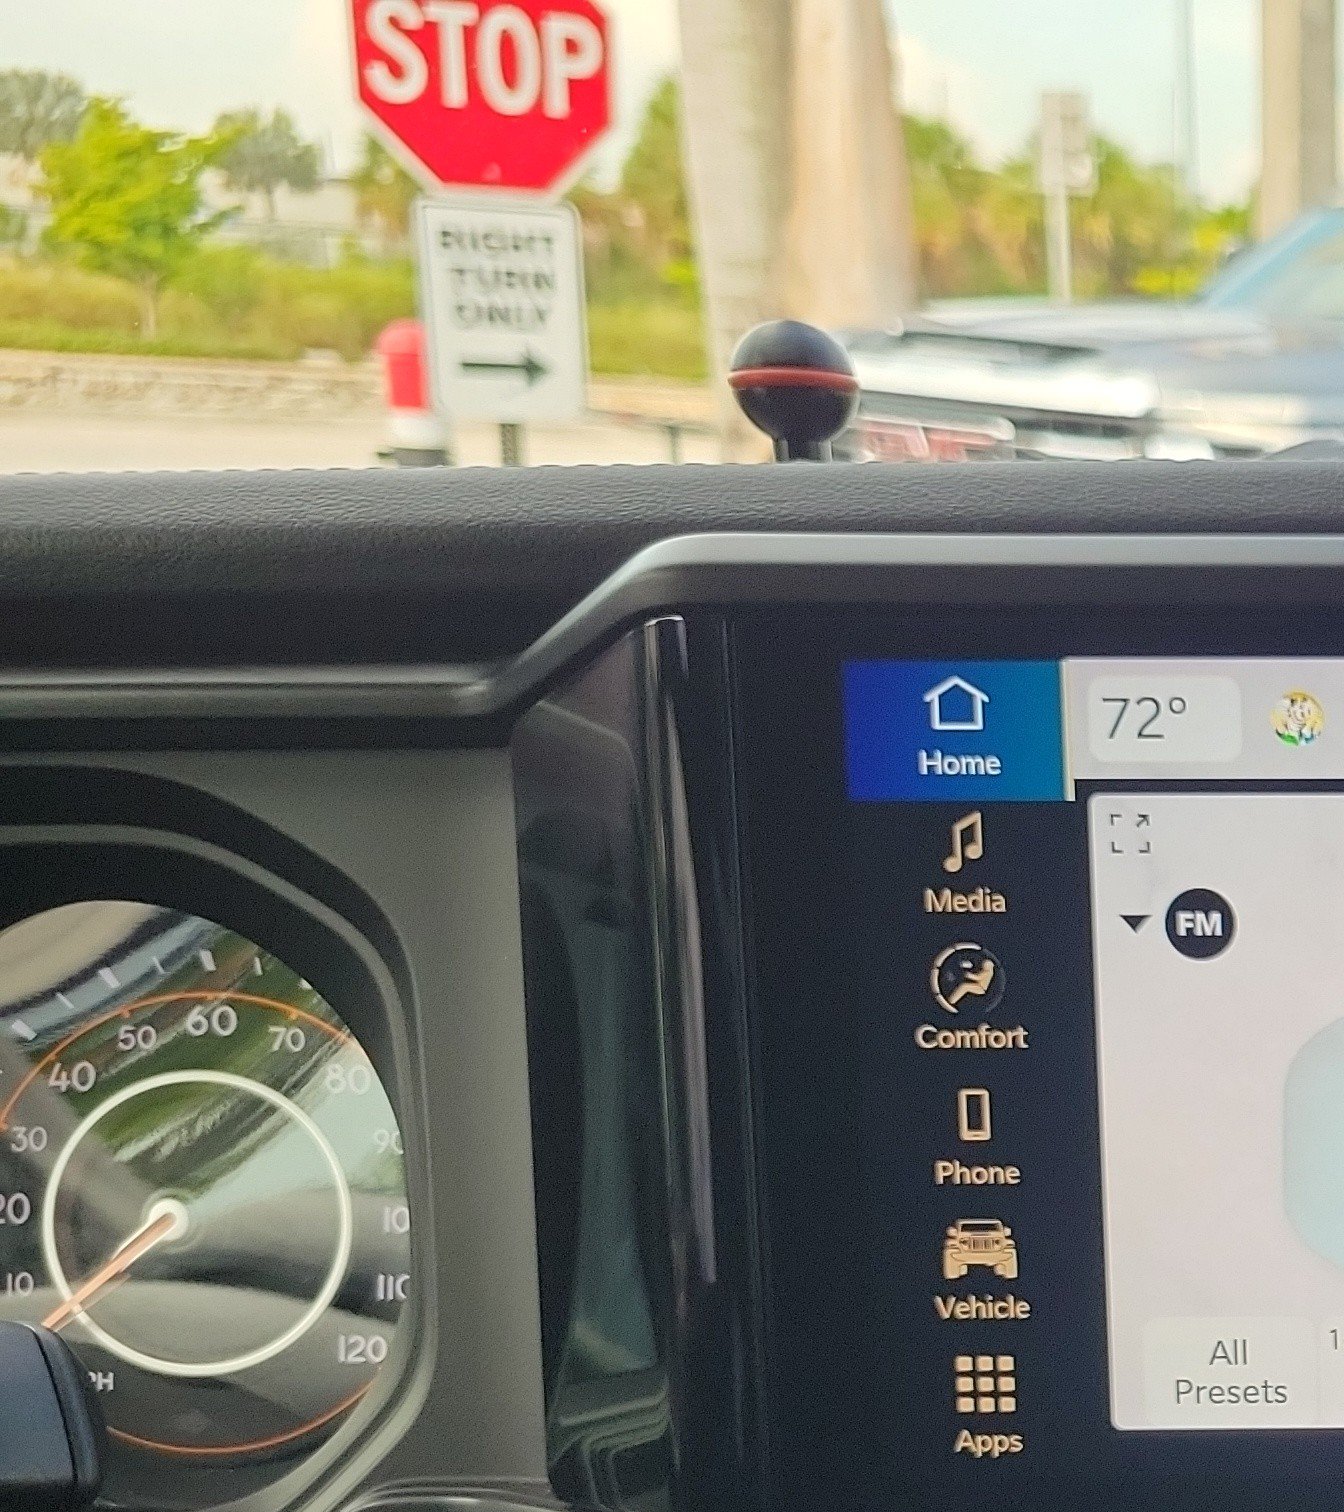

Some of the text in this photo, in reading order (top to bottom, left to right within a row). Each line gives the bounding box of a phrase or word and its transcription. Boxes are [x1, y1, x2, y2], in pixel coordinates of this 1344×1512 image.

[364, 0, 604, 119] STOP
[450, 266, 555, 290] TURN
[1101, 696, 1187, 741] 72°
[918, 750, 1002, 776] Home
[924, 887, 1007, 914] Media
[1175, 910, 1224, 938] FM
[186, 1005, 238, 1038] 60
[117, 1026, 158, 1051] 50
[268, 1026, 306, 1053] 70
[914, 1023, 1030, 1050] Comfort
[48, 1061, 97, 1093] 40
[324, 1065, 372, 1095] 80
[10, 1126, 48, 1153] 30
[933, 1160, 1022, 1186] Phone
[4, 1271, 35, 1297] 10
[933, 1294, 1032, 1320] Vehicle
[337, 1334, 388, 1364] 120
[1208, 1339, 1248, 1366] All
[1175, 1378, 1288, 1405] Presets
[953, 1430, 1024, 1458] Apps
